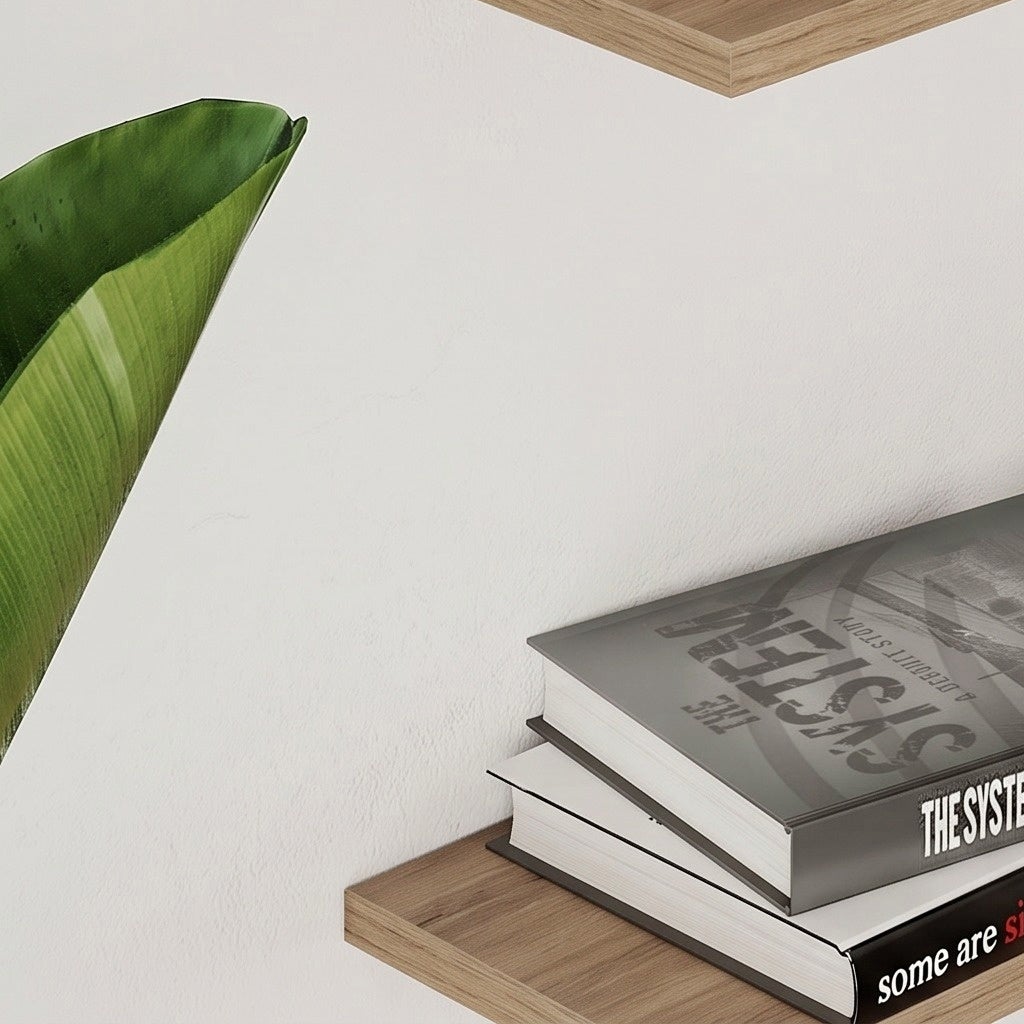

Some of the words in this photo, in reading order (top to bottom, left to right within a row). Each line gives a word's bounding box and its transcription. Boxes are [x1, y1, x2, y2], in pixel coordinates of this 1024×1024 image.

[680, 694, 761, 735] THE
[921, 790, 961, 858] THE
[878, 947, 949, 1004] some
[956, 925, 998, 967] are
